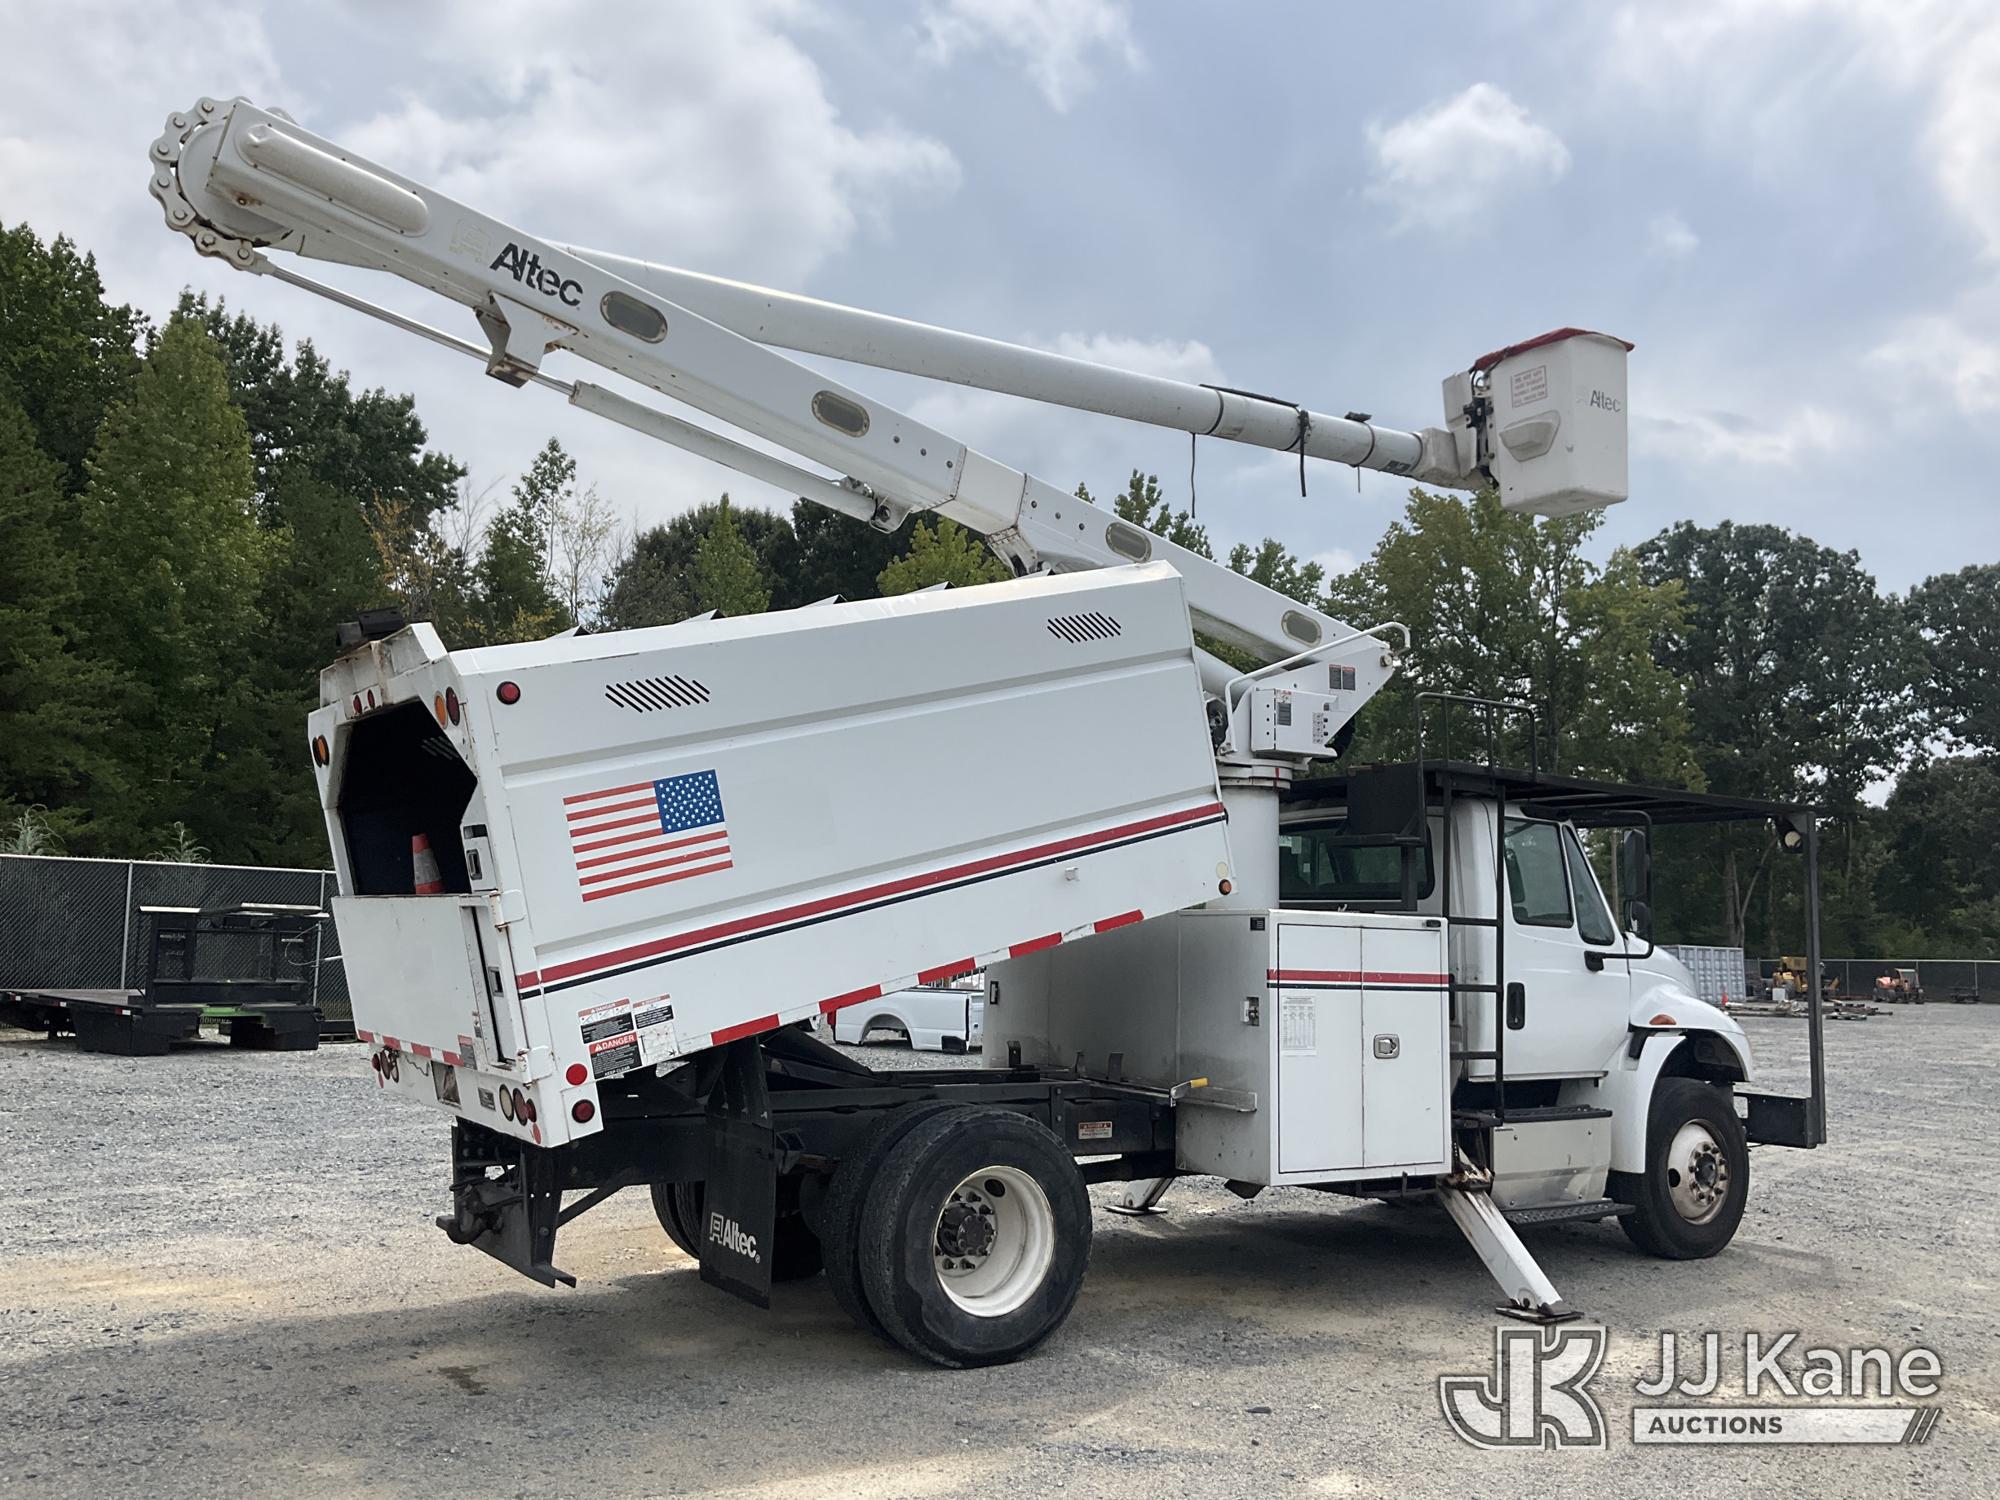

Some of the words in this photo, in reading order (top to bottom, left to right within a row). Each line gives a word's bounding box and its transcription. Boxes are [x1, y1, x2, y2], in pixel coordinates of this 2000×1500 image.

[489, 241, 583, 307] Altec
[1589, 389, 1622, 413] Altec
[601, 1034, 635, 1050] DANGER
[722, 1218, 757, 1259] Altec
